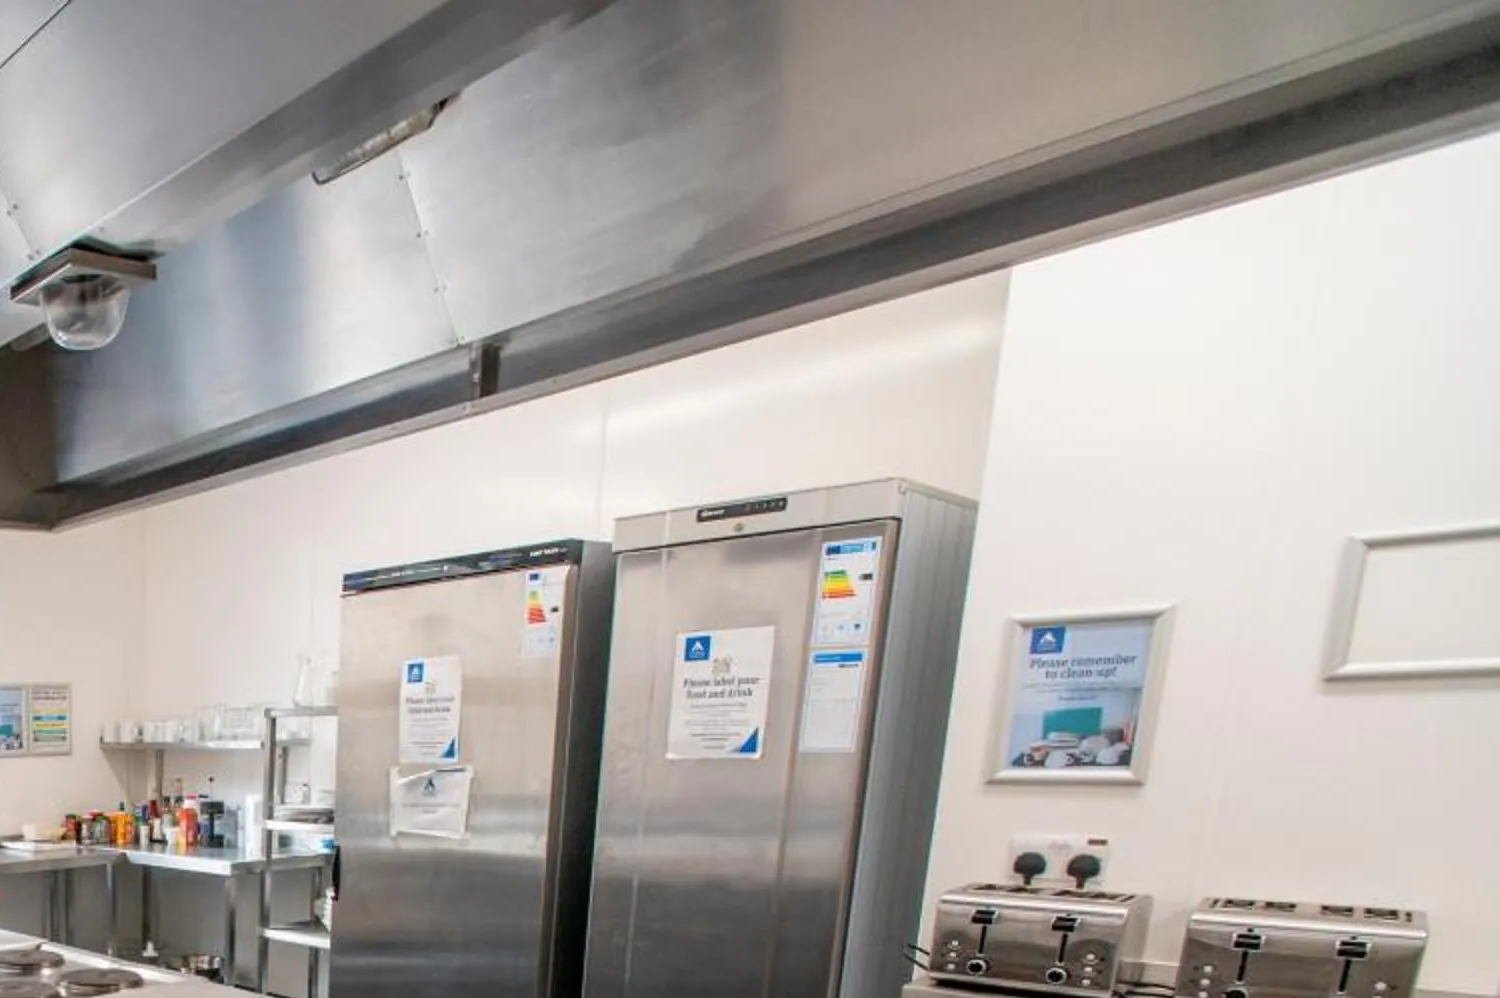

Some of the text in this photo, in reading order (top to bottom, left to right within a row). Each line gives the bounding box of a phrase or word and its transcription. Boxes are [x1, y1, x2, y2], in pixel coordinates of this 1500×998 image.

[1029, 654, 1138, 669] Please remember
[1060, 668, 1093, 679] clean
